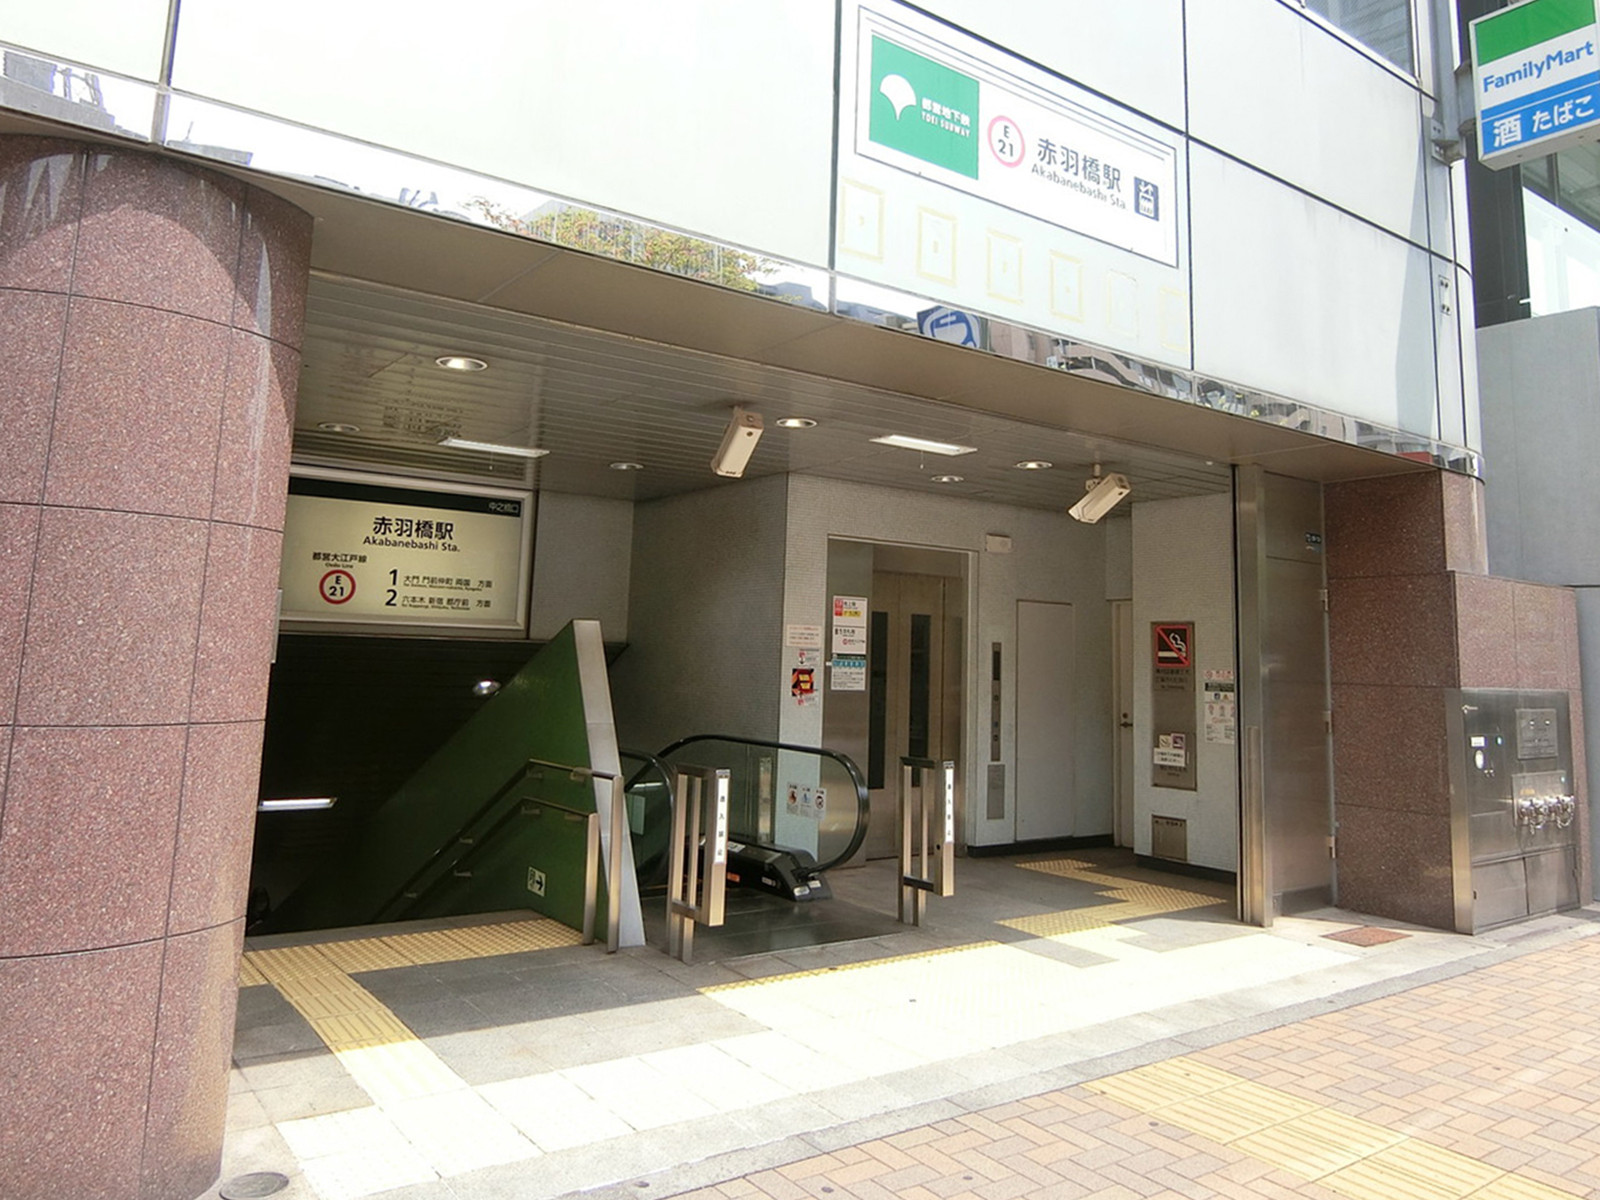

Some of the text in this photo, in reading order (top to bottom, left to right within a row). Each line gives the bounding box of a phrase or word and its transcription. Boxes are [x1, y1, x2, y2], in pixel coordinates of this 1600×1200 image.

[1483, 41, 1594, 93] FamilyMart
[921, 110, 971, 138] TOEI SUBWAY
[1493, 94, 1595, 148] 酒 たばこ
[1004, 124, 1010, 139] E
[998, 139, 1014, 158] 21
[1037, 138, 1122, 193] 赤羽橋駅
[1031, 163, 1107, 202] Akabanebashi
[373, 516, 454, 540] 赤羽橋駅
[363, 536, 461, 552] Akabanebashi Sta.
[312, 551, 368, 564] 都営大江戸線
[335, 575, 342, 585] E
[388, 568, 398, 586] 1
[329, 585, 345, 597] 21
[385, 588, 398, 606] 2
